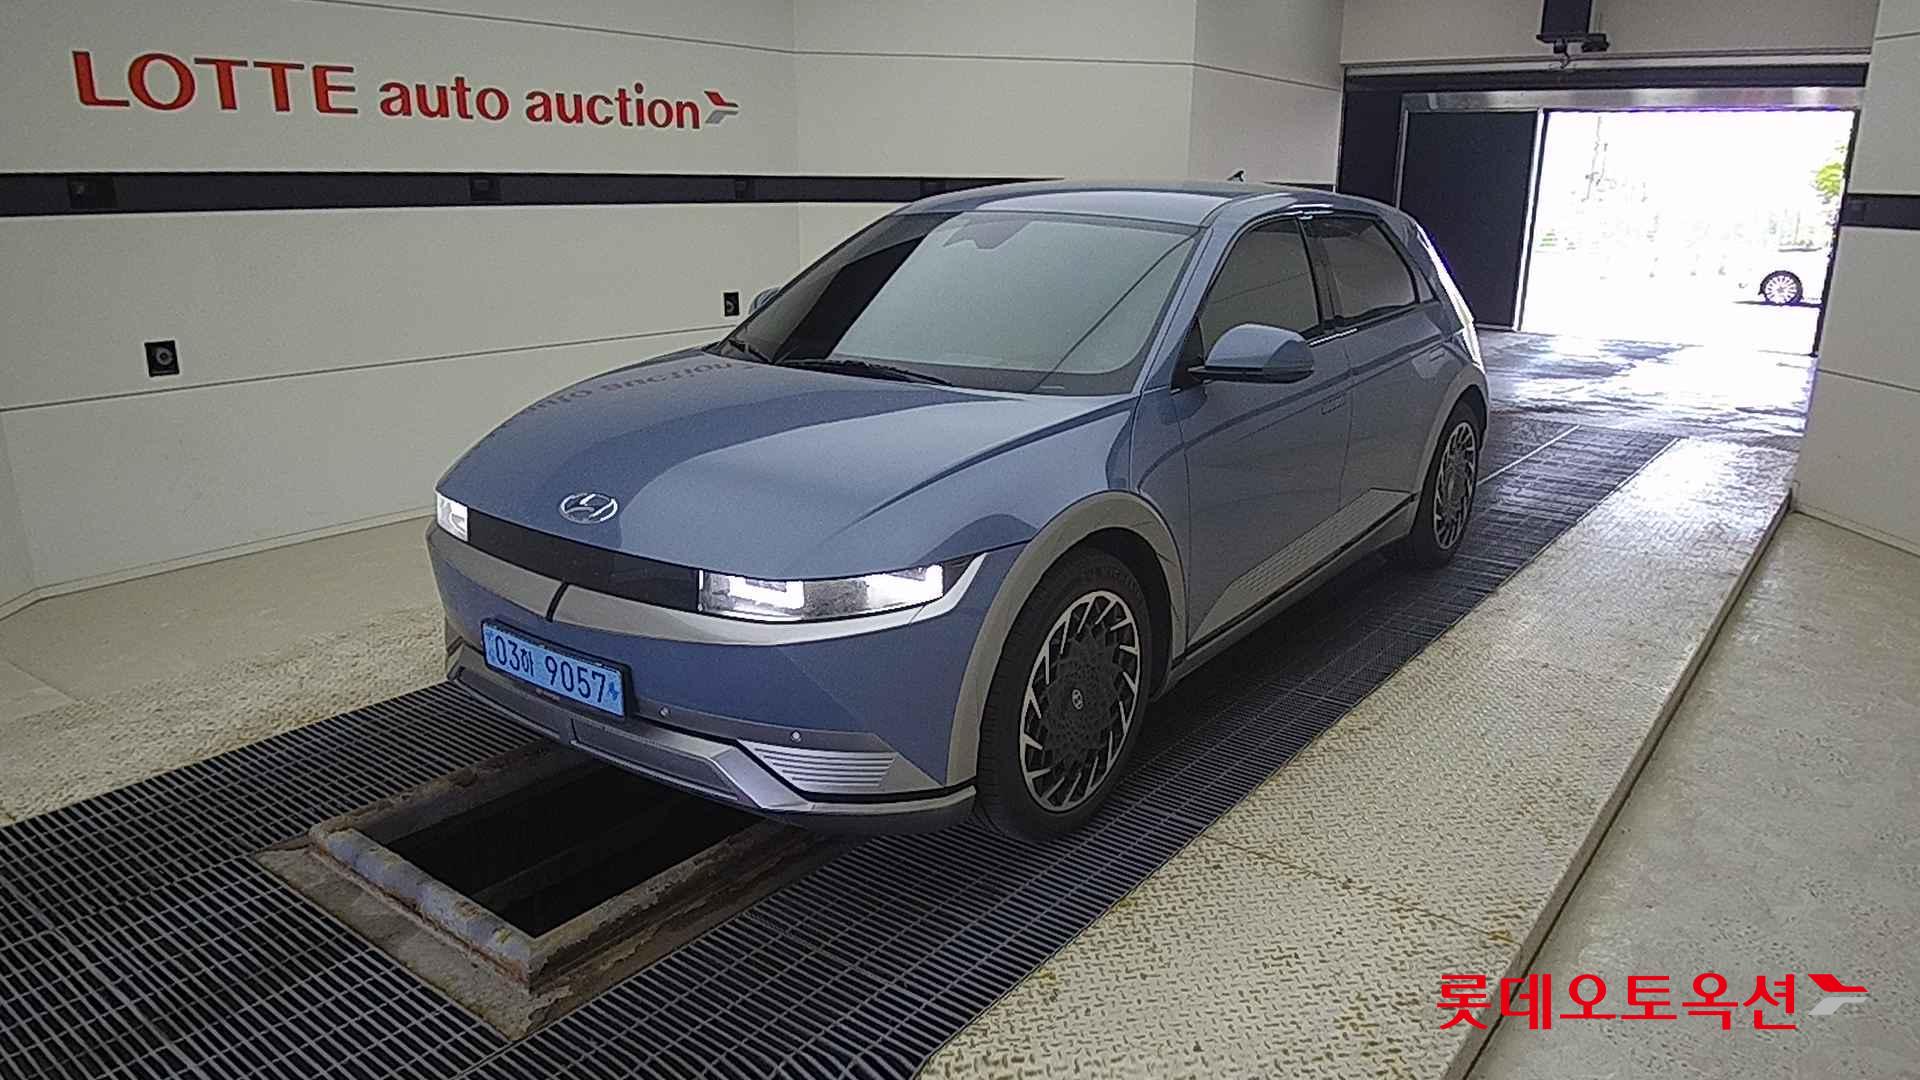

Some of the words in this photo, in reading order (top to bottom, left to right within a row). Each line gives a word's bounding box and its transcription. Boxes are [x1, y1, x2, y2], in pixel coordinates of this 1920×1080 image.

[72, 50, 358, 115] LOTTE
[379, 76, 511, 121] auto
[525, 83, 701, 129] auction
[495, 635, 535, 677] 03하
[545, 655, 606, 703] 9057
